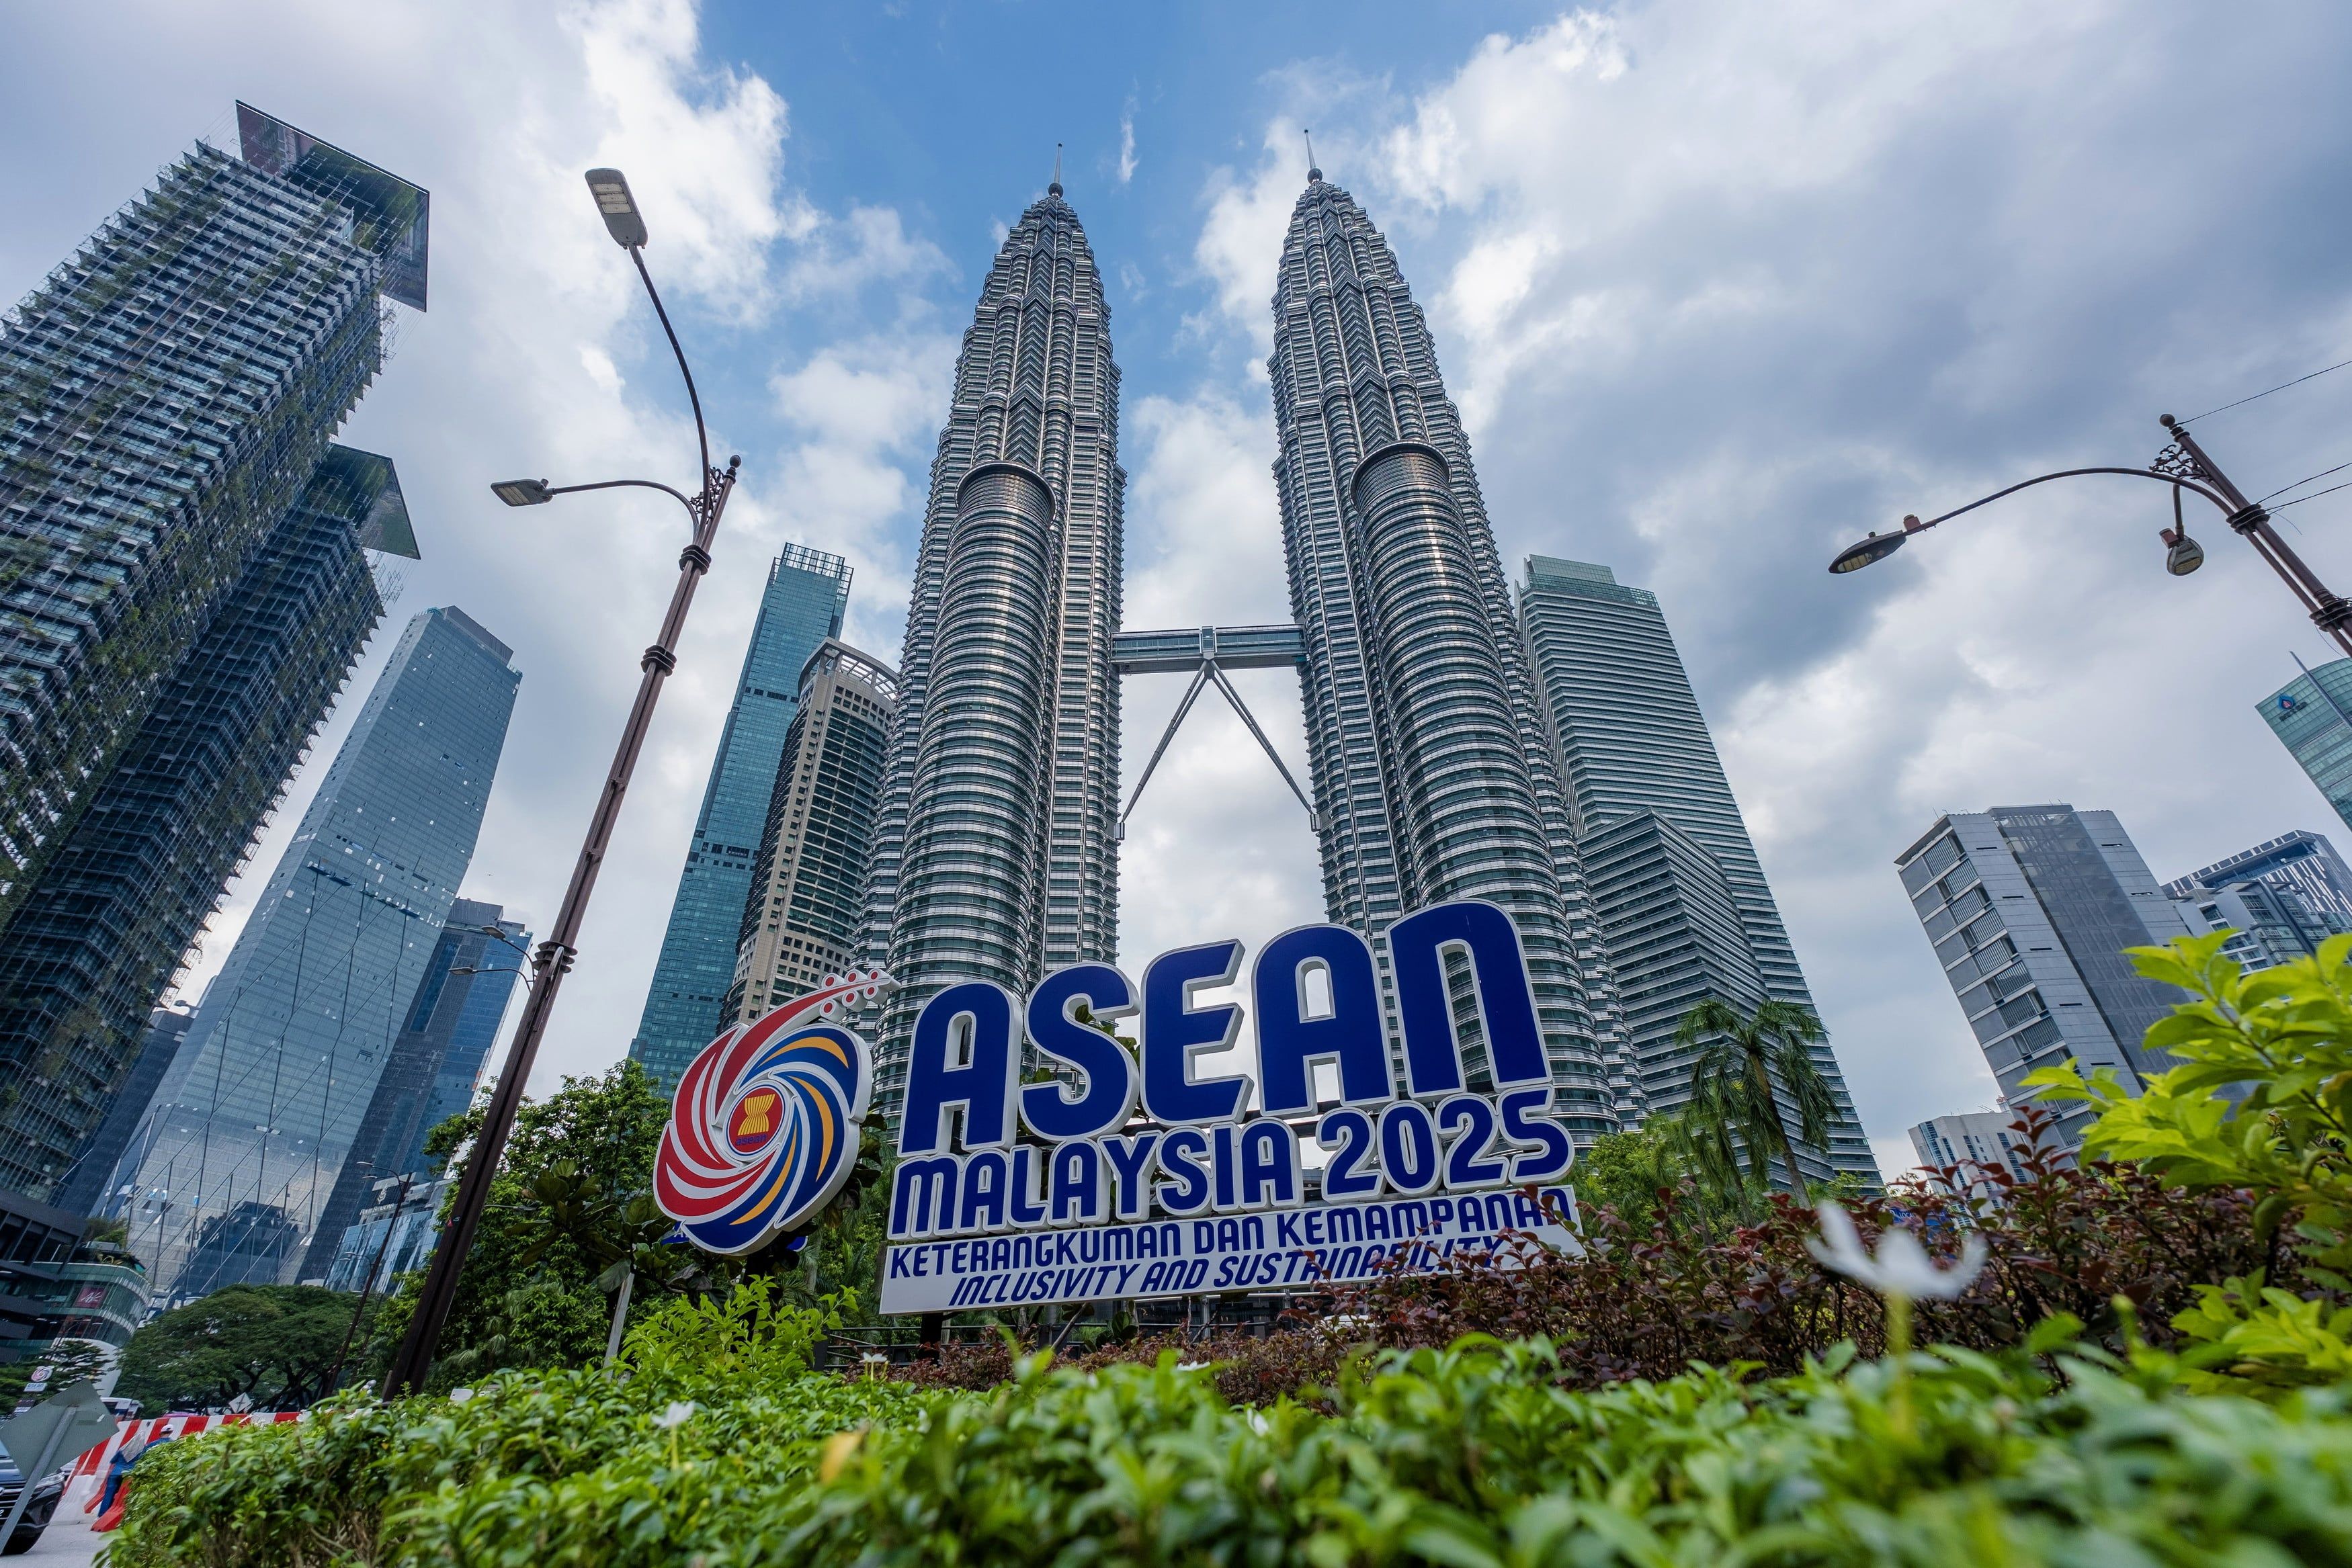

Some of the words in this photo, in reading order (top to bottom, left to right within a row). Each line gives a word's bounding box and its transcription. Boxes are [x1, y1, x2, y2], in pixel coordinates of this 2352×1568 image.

[900, 902, 1548, 1153] ASEAN
[737, 1134, 767, 1145] asean
[891, 1122, 1294, 1235] MALAYSIA
[1320, 1089, 1569, 1204] 2025
[890, 1229, 1182, 1278] KETERANGKUMAN
[1193, 1216, 1265, 1256] DAN
[1276, 1188, 1572, 1248] KEMAMPANAN
[948, 1263, 1142, 1307] INCLUSIVITY
[1140, 1258, 1210, 1293] AND
